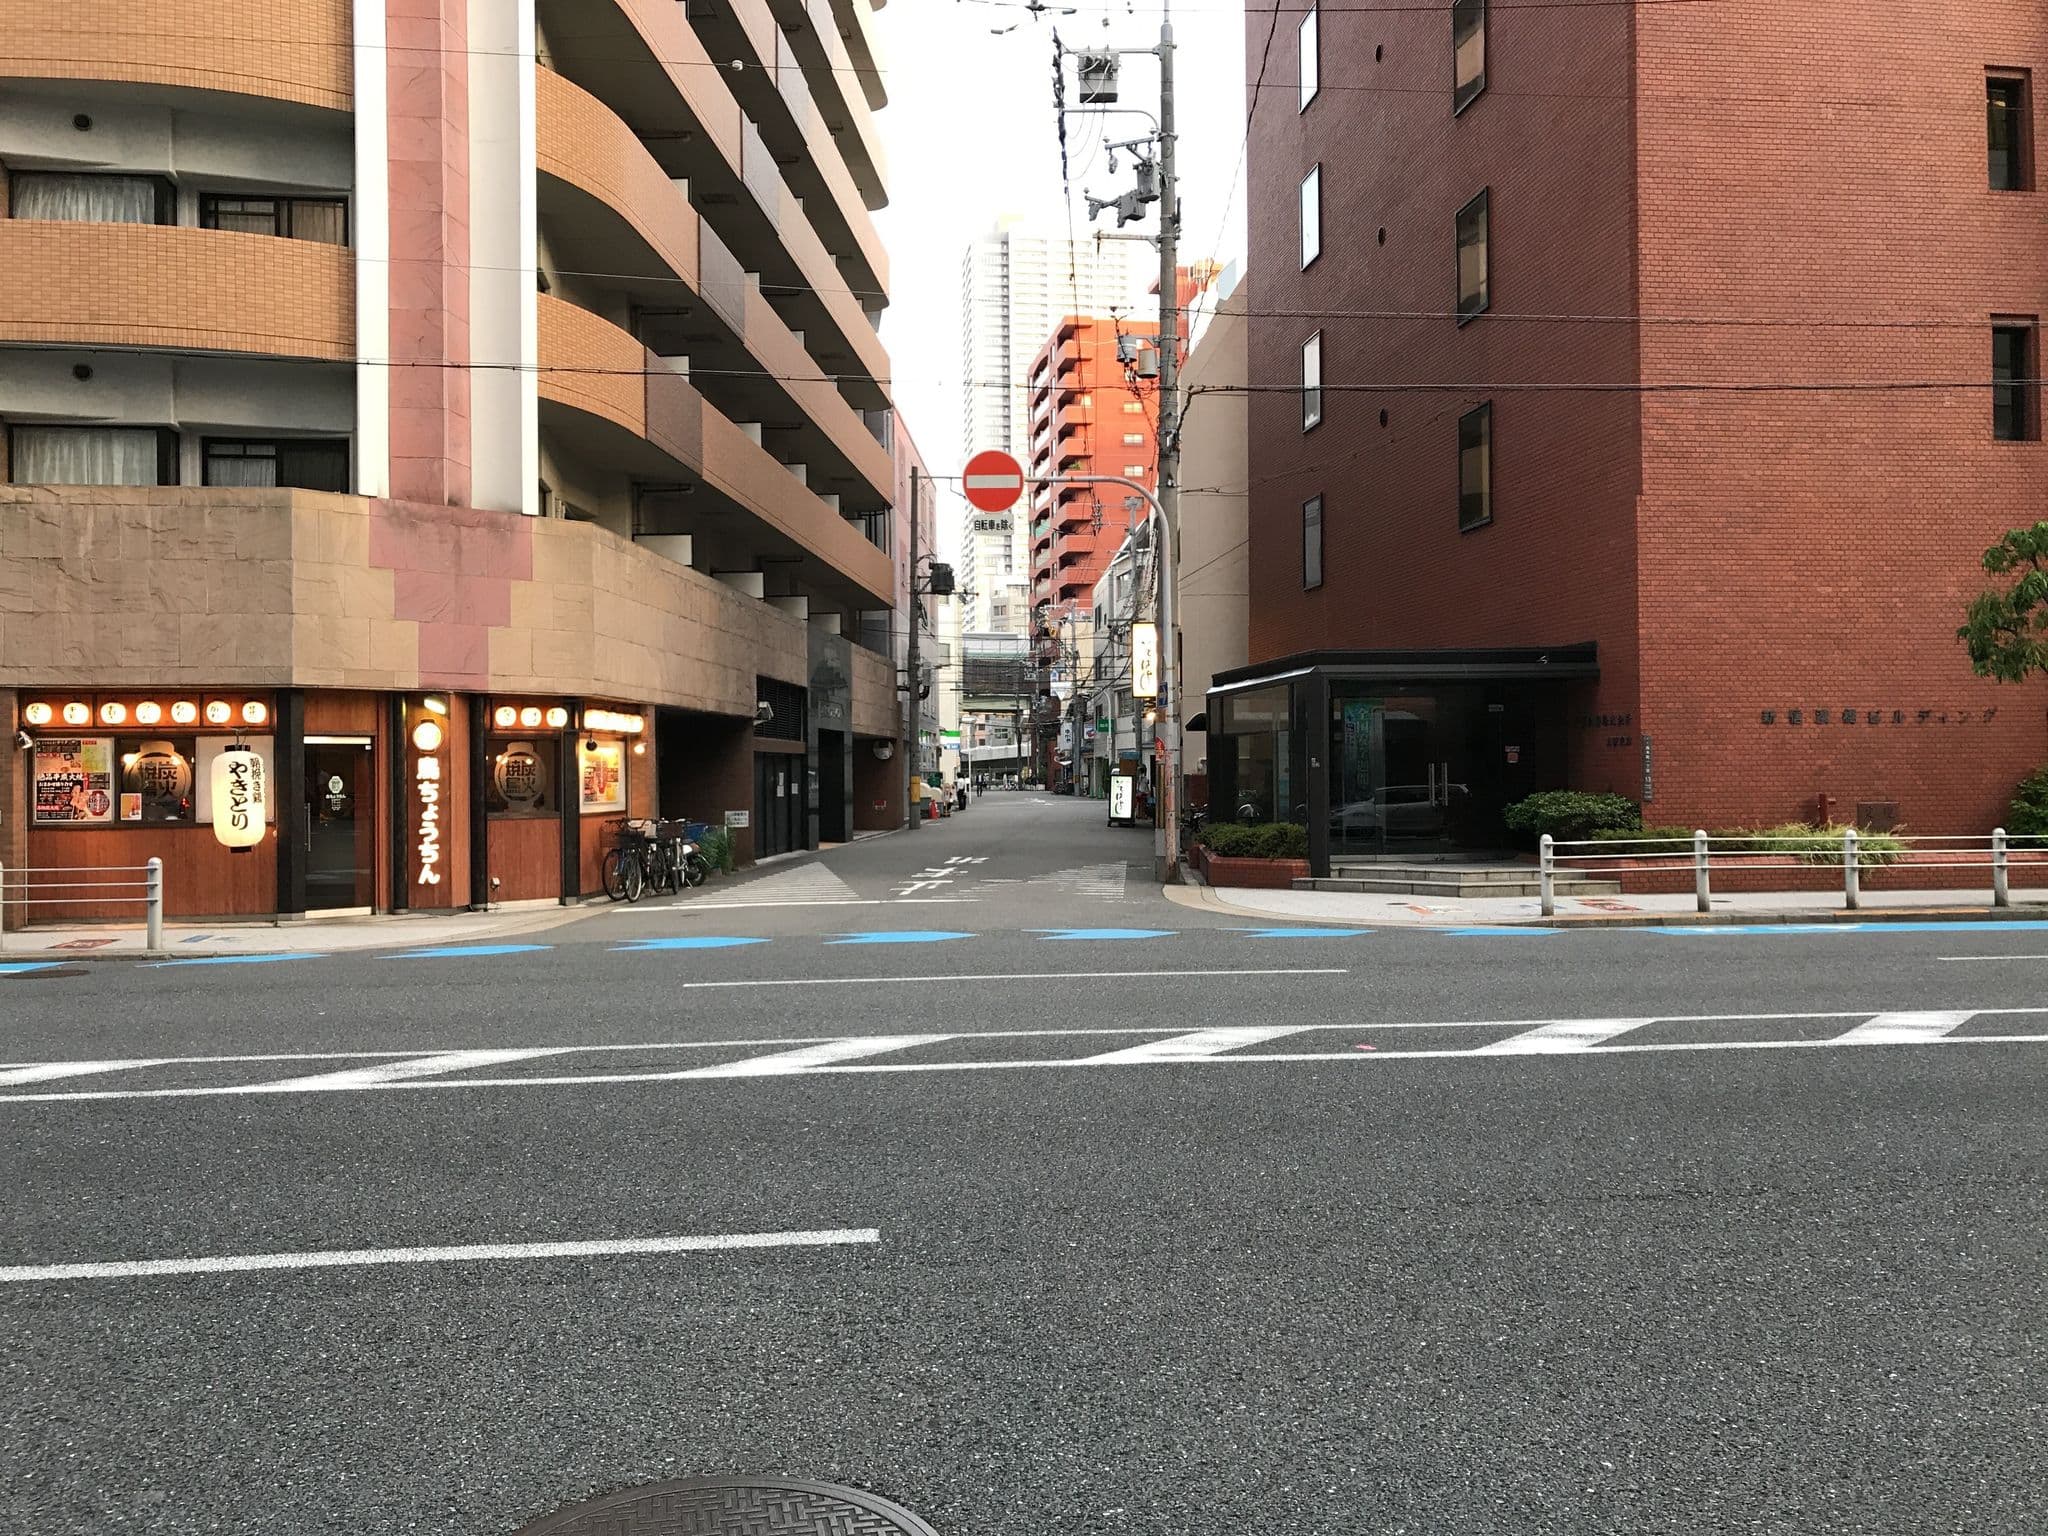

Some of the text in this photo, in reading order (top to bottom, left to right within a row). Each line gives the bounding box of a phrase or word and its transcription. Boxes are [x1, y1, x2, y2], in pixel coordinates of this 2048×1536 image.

[974, 519, 1015, 531] 自転車を除く
[229, 761, 248, 830] やきとり
[416, 756, 441, 885] 鳥ちょうちん
